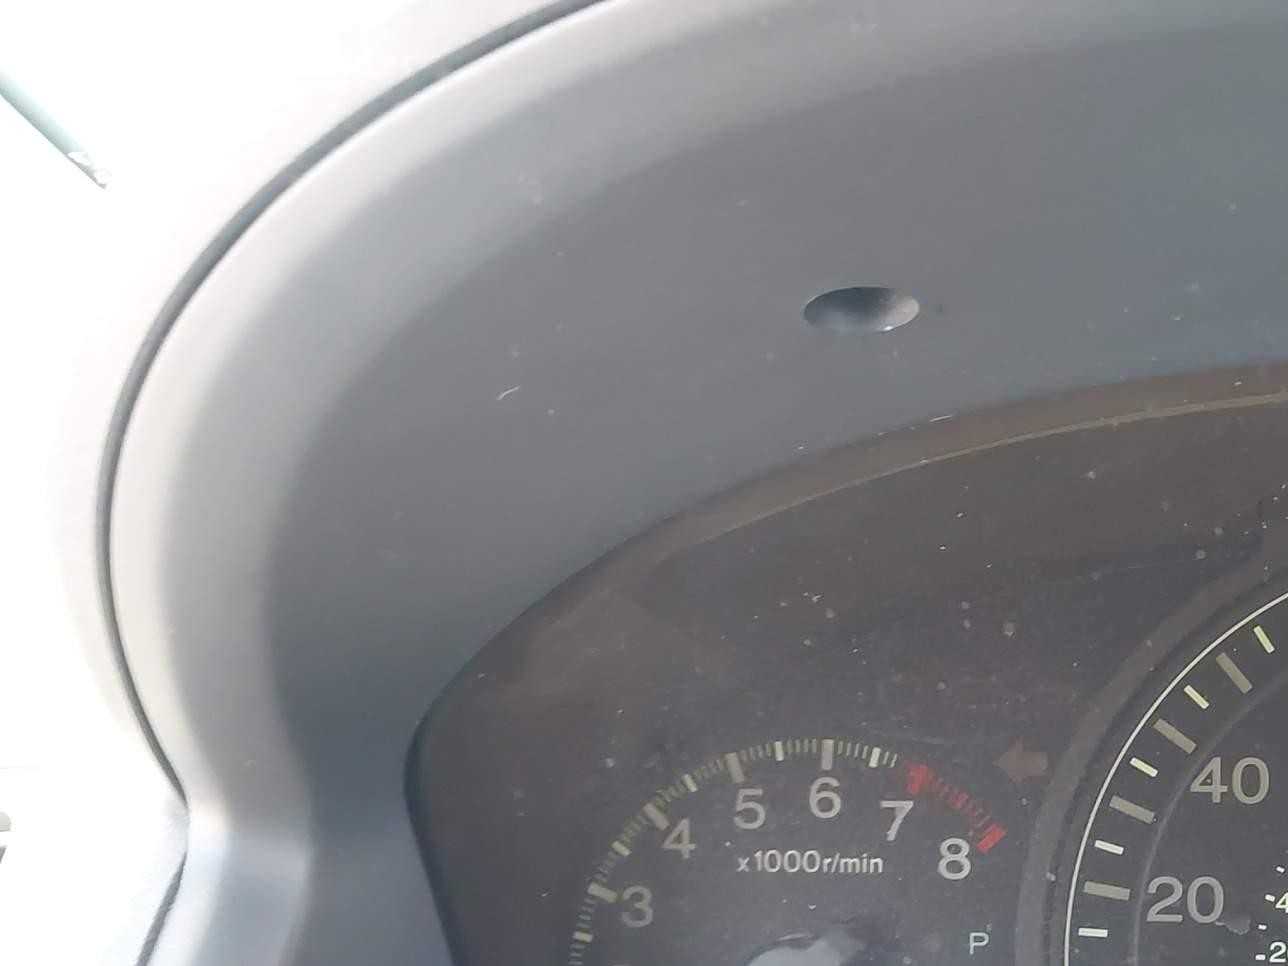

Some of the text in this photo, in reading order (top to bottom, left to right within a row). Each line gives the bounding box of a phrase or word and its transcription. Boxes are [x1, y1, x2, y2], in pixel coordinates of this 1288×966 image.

[808, 777, 842, 819] 6
[1190, 756, 1270, 805] 40
[733, 788, 767, 830] 5
[880, 800, 914, 841] 7
[663, 819, 696, 860] 4
[937, 838, 972, 880] 8
[736, 849, 884, 876] x1000r/min
[620, 886, 654, 928] 3
[1145, 875, 1225, 924] 20
[968, 932, 990, 955] P
